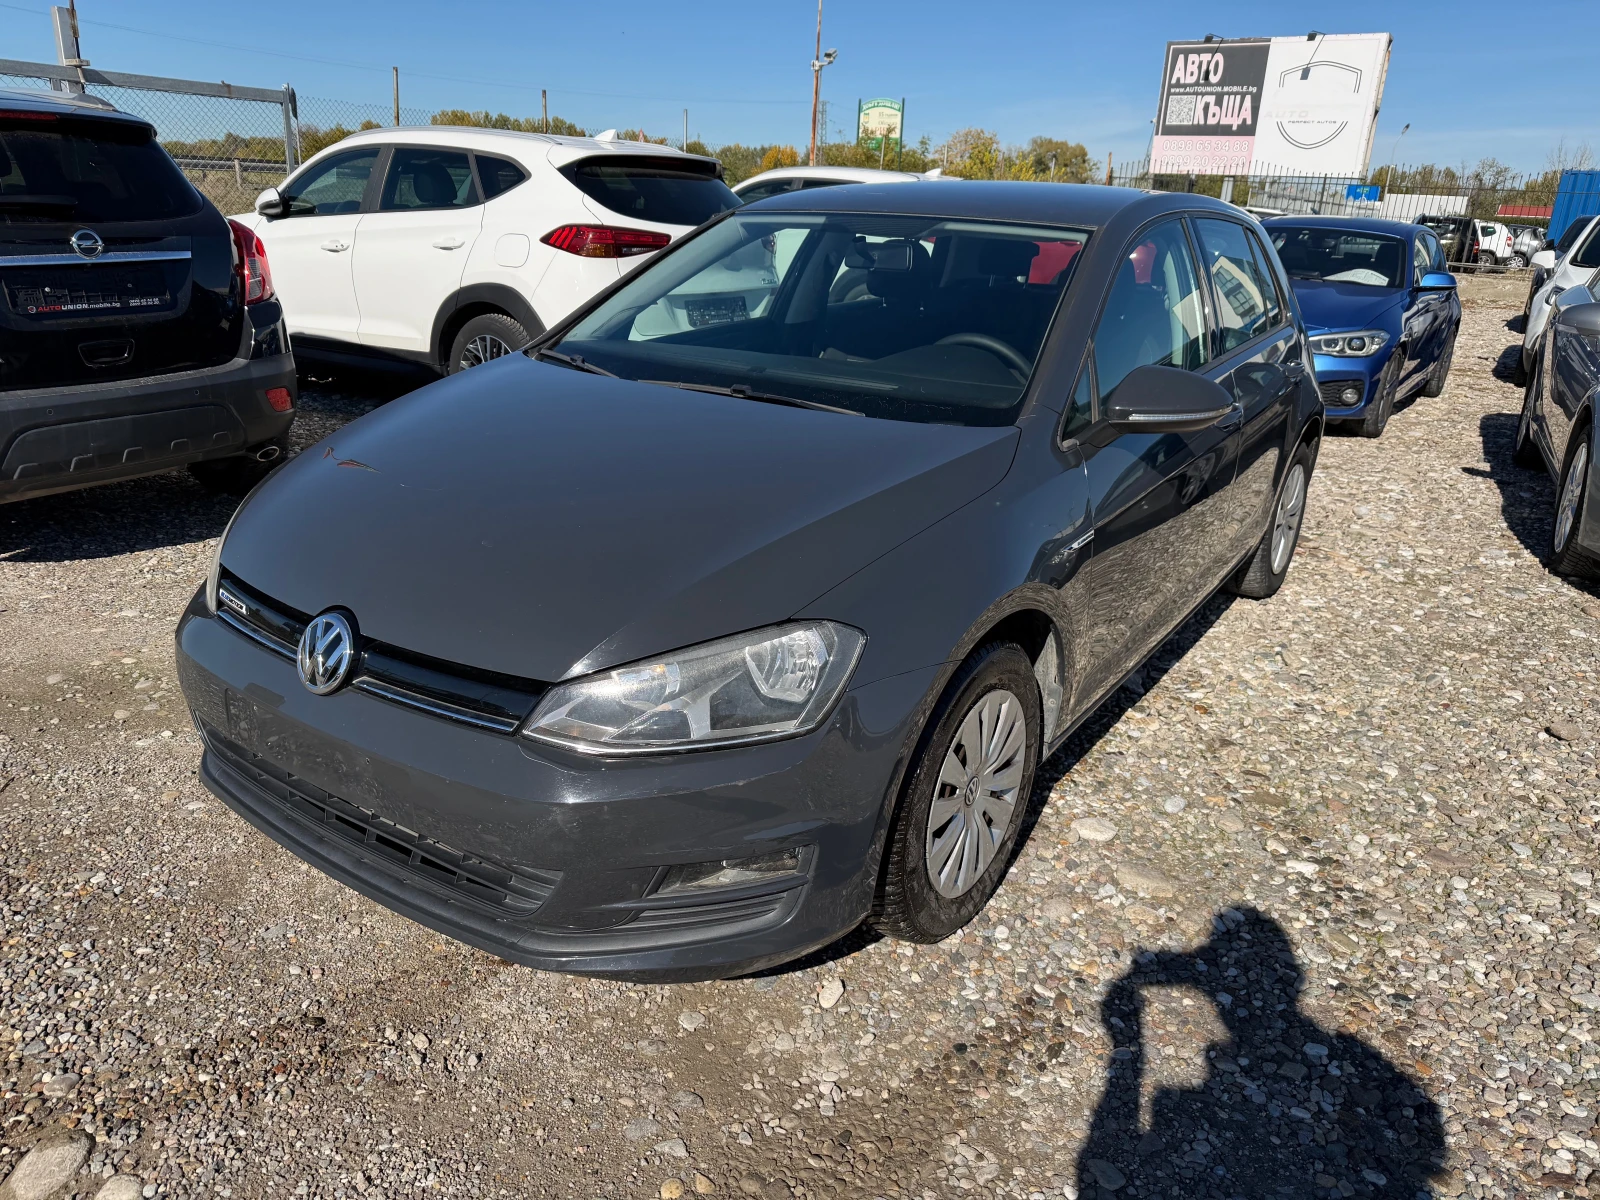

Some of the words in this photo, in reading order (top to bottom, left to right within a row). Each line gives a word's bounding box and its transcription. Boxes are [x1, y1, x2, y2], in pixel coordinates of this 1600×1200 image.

[1171, 53, 1224, 84] АВТО
[1193, 94, 1252, 130] КЪЩА
[1163, 140, 1193, 151] 0898
[1196, 140, 1211, 151] 65
[1214, 140, 1229, 152] 34
[1233, 141, 1249, 152] 88
[1161, 155, 1191, 166] 0899
[1193, 155, 1209, 167] 20
[1212, 156, 1228, 167] 22
[1231, 156, 1246, 167] 20
